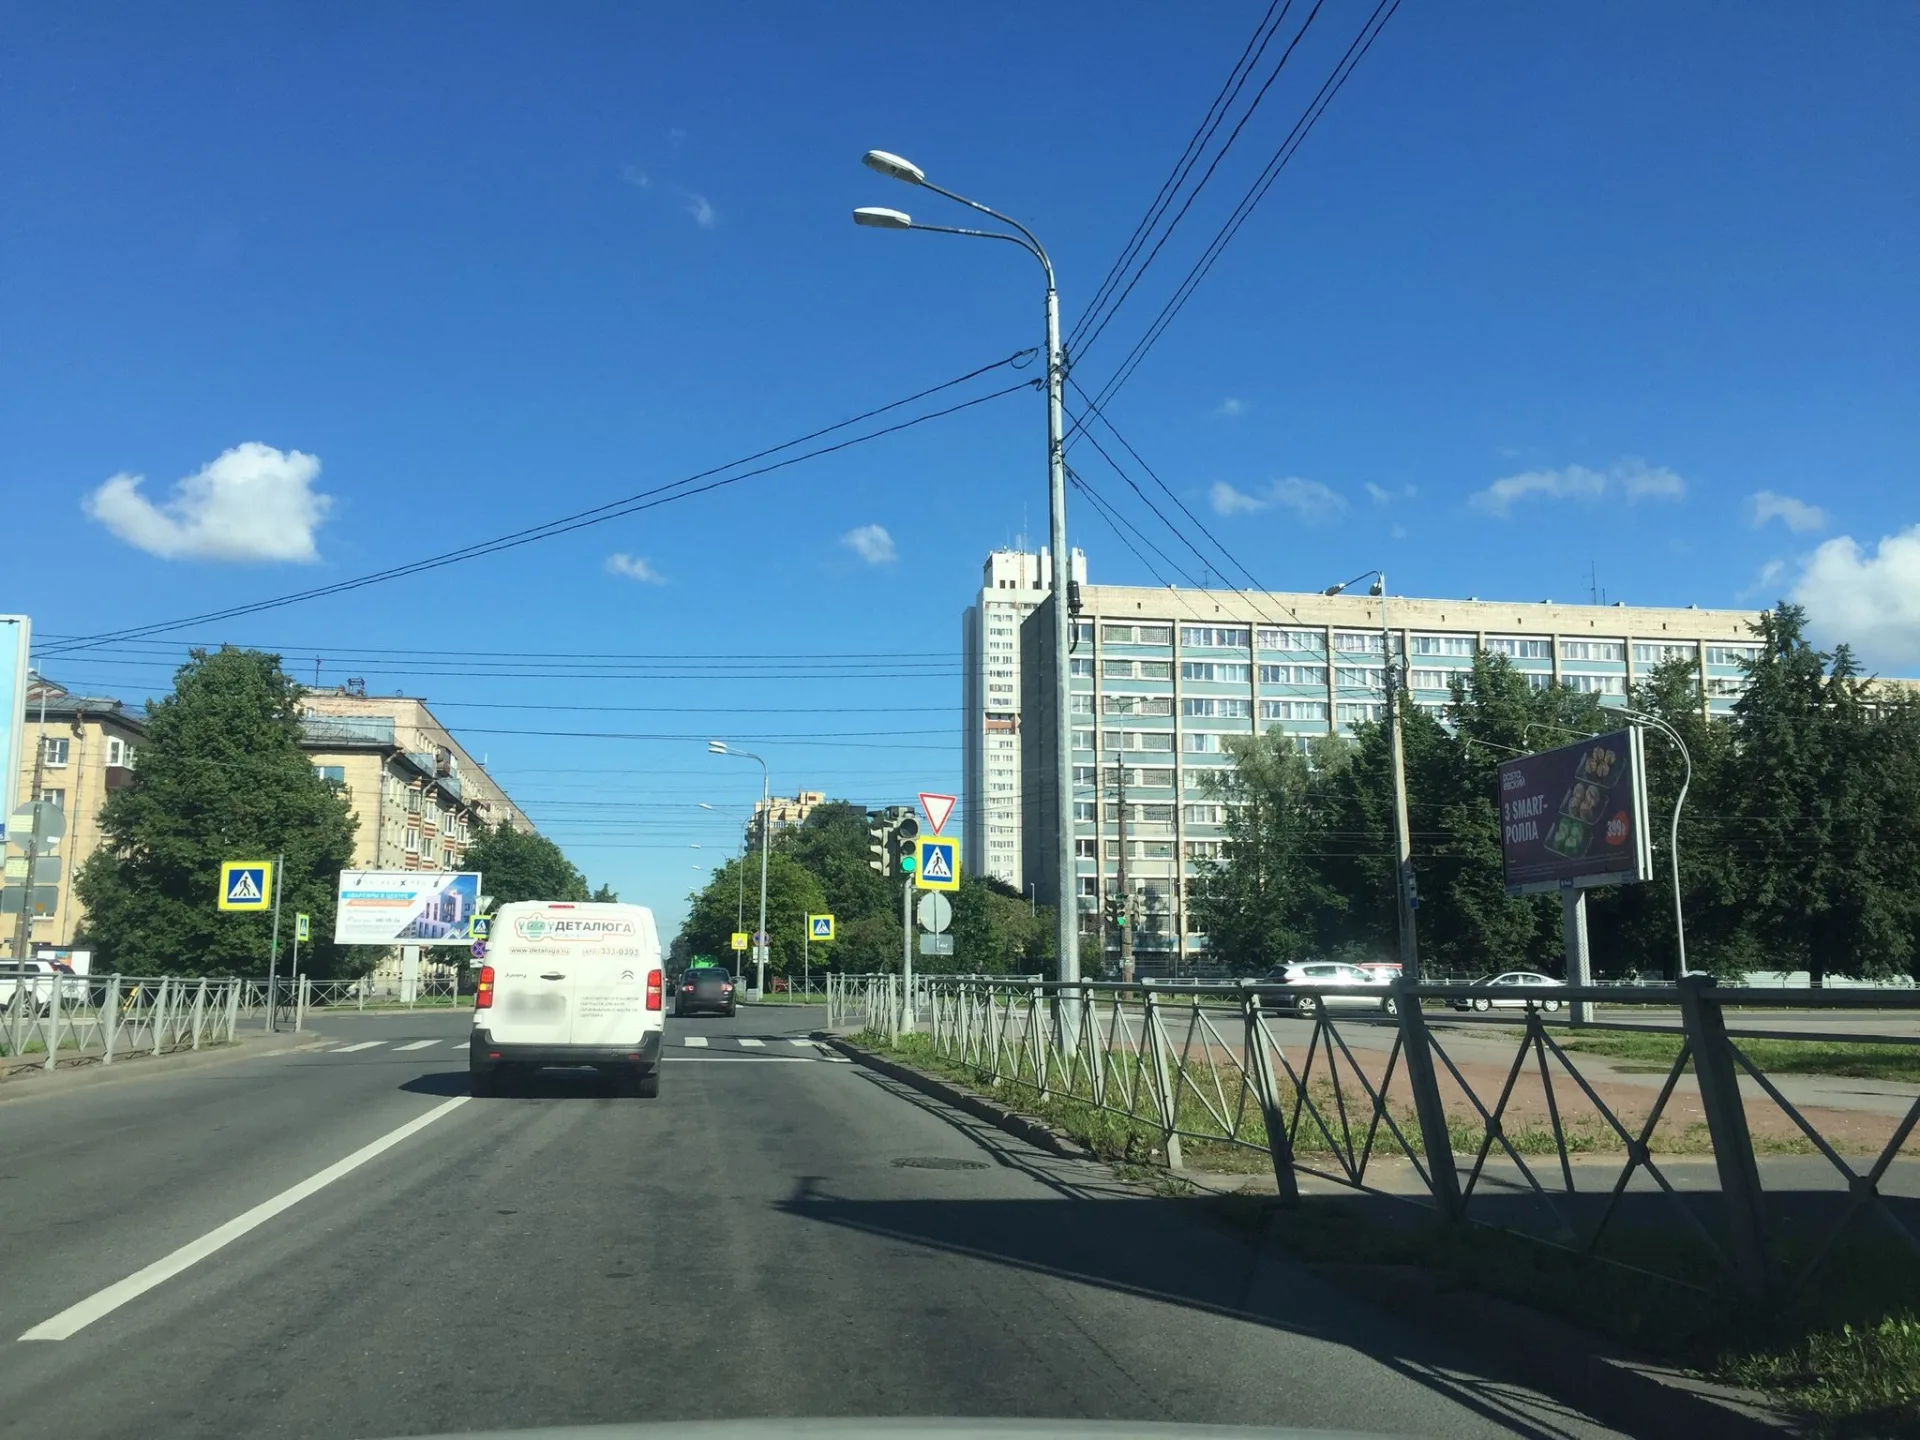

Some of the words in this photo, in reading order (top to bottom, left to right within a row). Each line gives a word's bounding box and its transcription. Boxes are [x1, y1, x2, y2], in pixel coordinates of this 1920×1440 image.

[1504, 802, 1511, 821] 3
[1512, 794, 1549, 820] SMART-
[1505, 820, 1539, 844] РОЛЛА
[555, 921, 631, 933] ДЕТАЛЮГА
